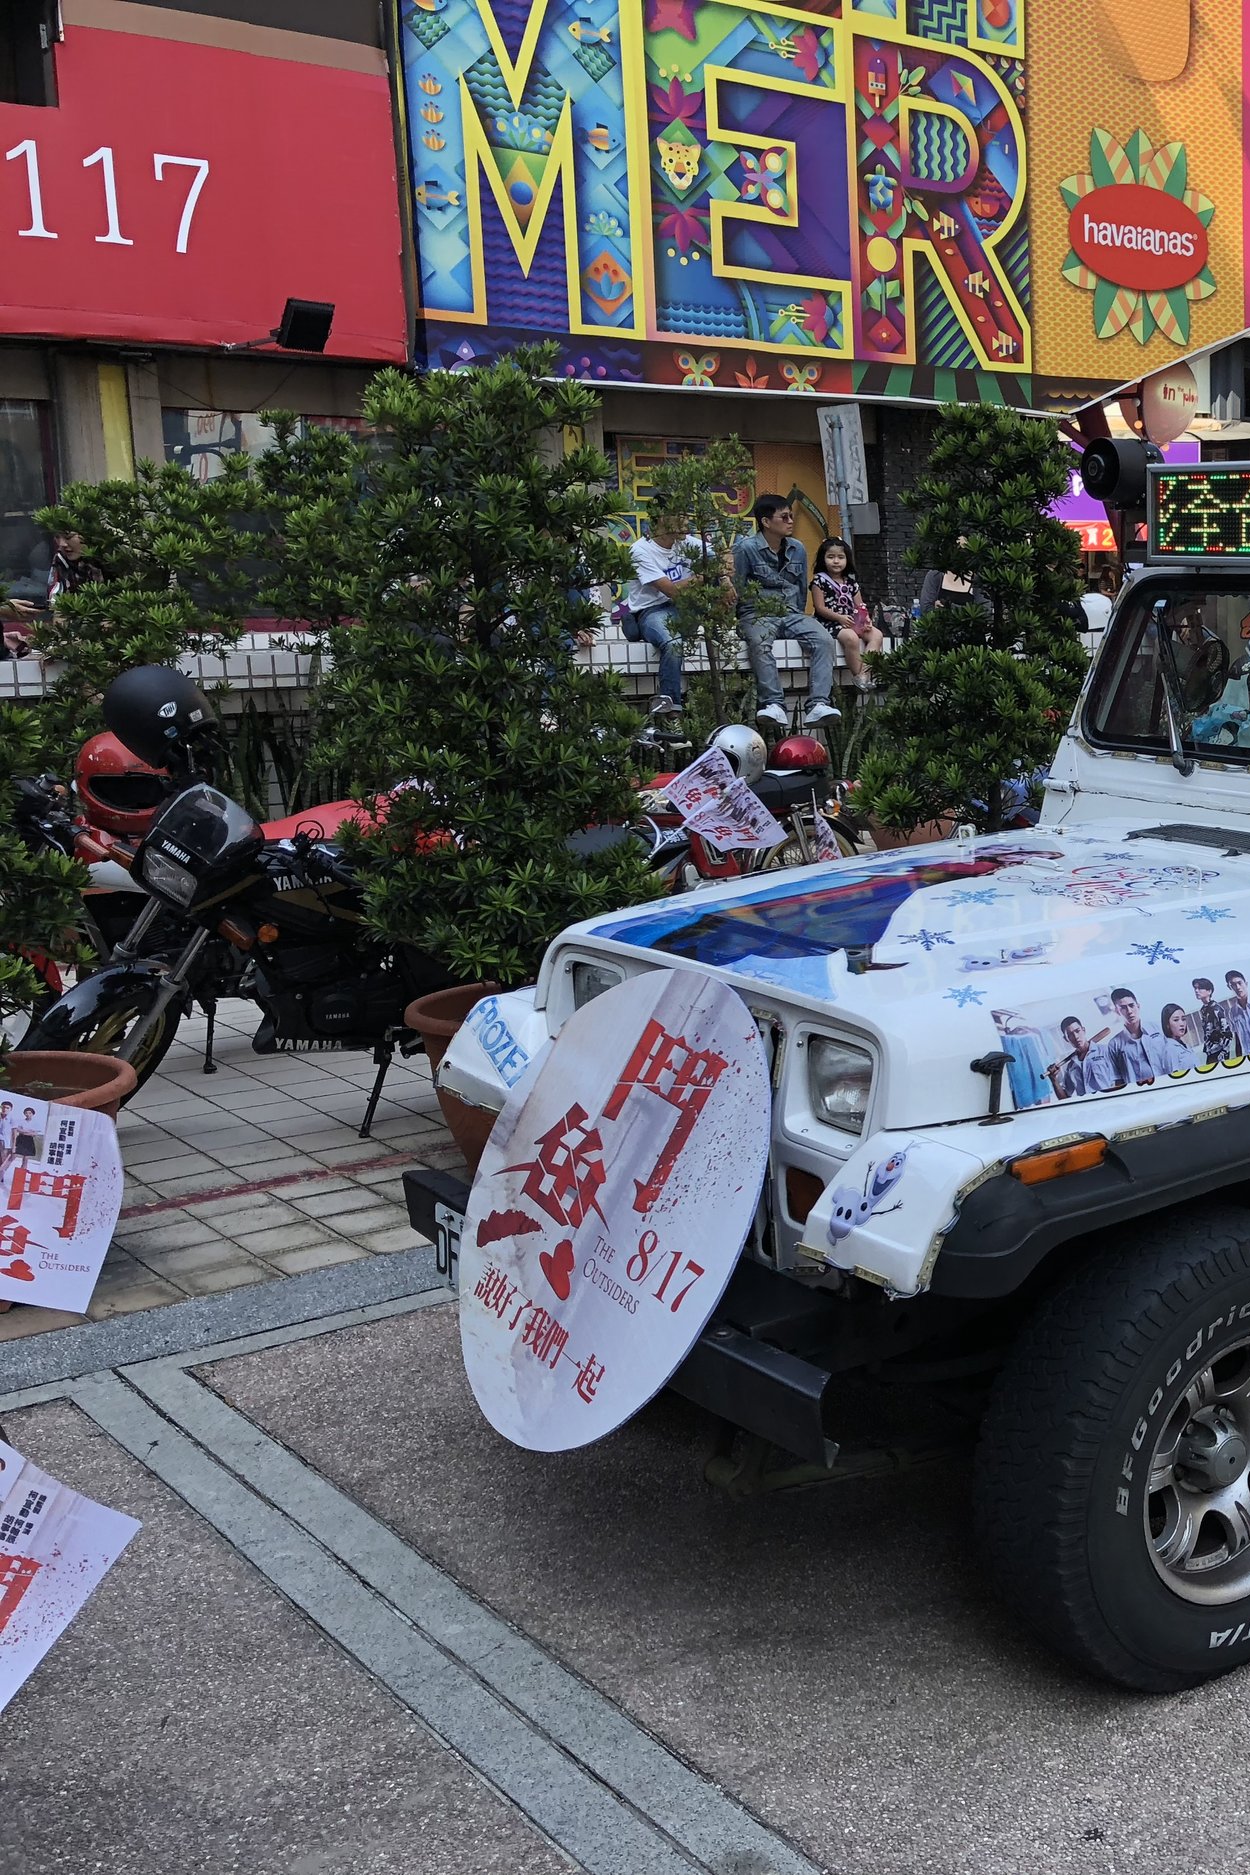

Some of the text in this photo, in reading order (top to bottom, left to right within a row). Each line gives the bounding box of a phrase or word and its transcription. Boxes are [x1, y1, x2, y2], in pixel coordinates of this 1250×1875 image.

[5, 139, 210, 254] 117
[1083, 213, 1196, 257] havaianas
[161, 839, 192, 864] YAMAHA
[325, 1012, 351, 1020] YAMAHA
[275, 1037, 343, 1051] YAMAHA
[40, 1251, 59, 1261] THE
[594, 1234, 617, 1264] THE
[38, 1260, 91, 1273] OUTSIDERS
[626, 1229, 705, 1314] 8/17
[582, 1257, 641, 1315] OUTSIDERS
[474, 1261, 606, 1405] 說好了我們一起
